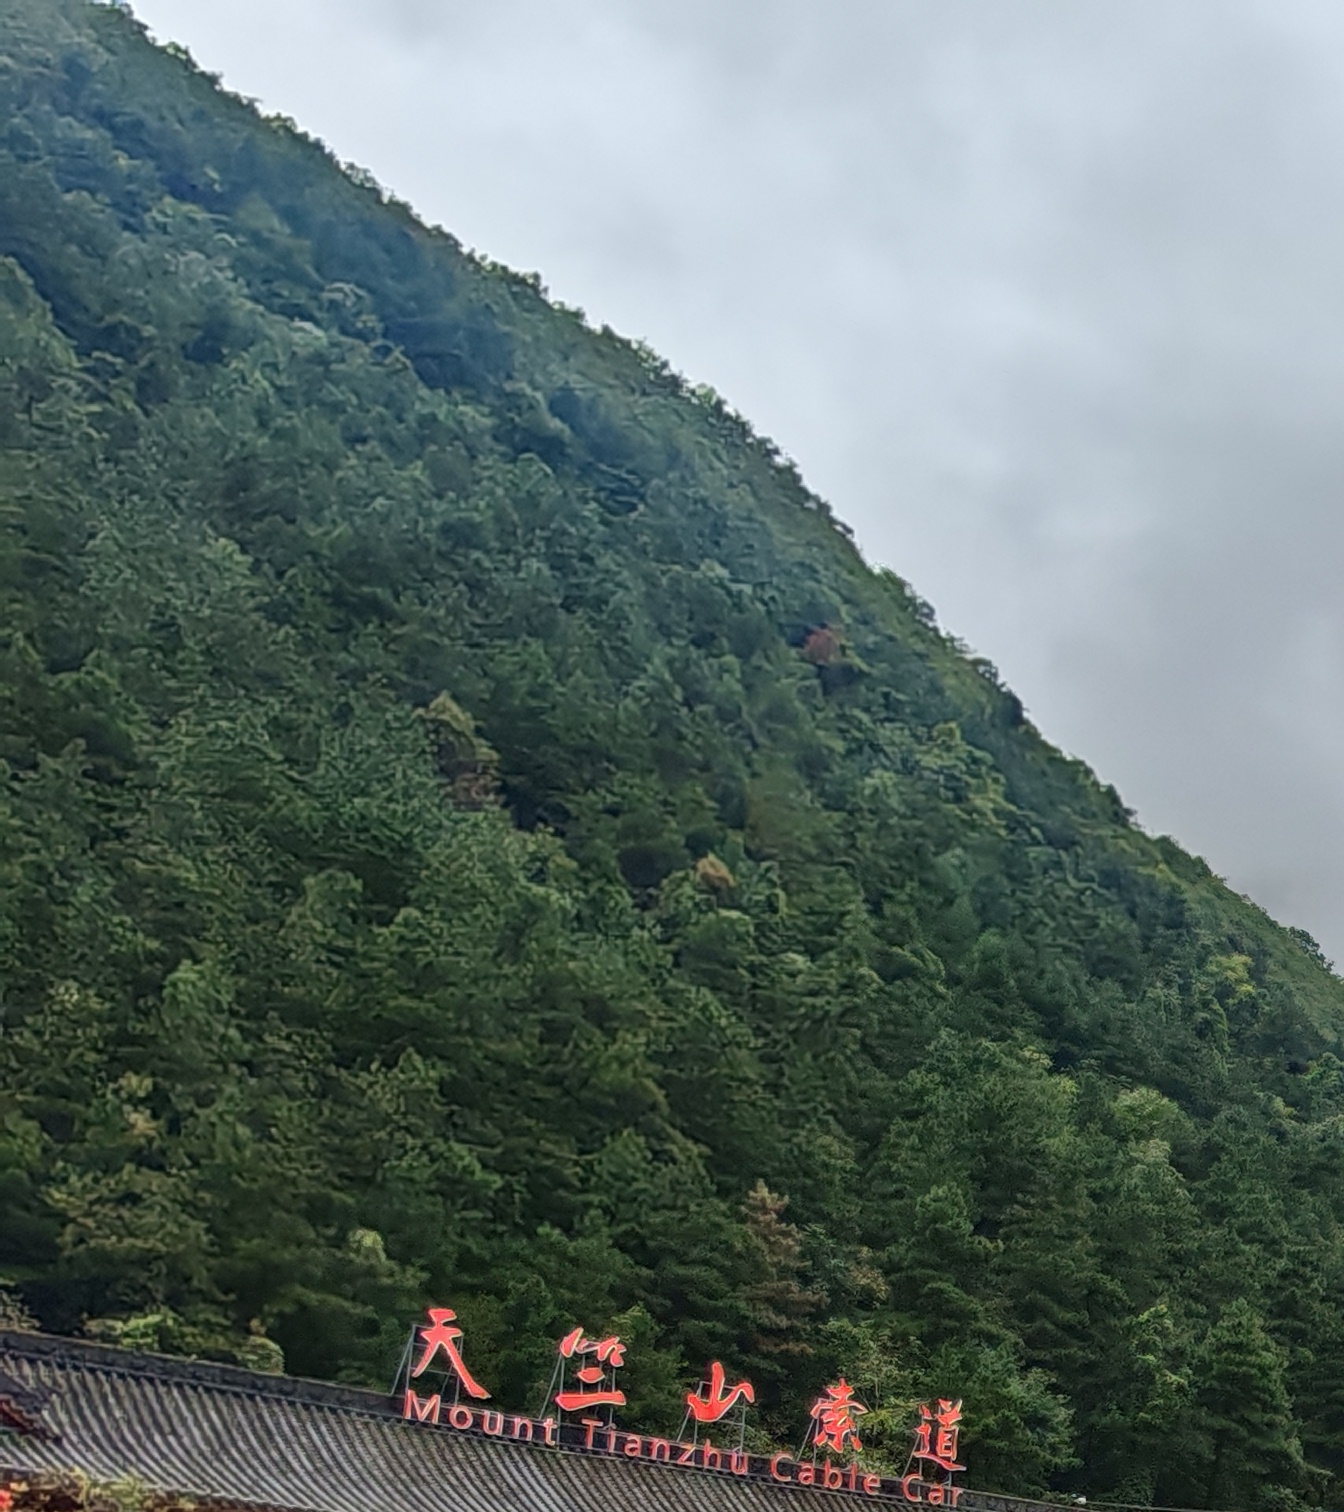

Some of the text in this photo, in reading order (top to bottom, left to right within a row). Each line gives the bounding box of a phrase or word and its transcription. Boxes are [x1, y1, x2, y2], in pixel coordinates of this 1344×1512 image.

[403, 1389, 963, 1508] Mount Tianzhu Cable Car
[411, 1307, 967, 1471] 天竺山索道
